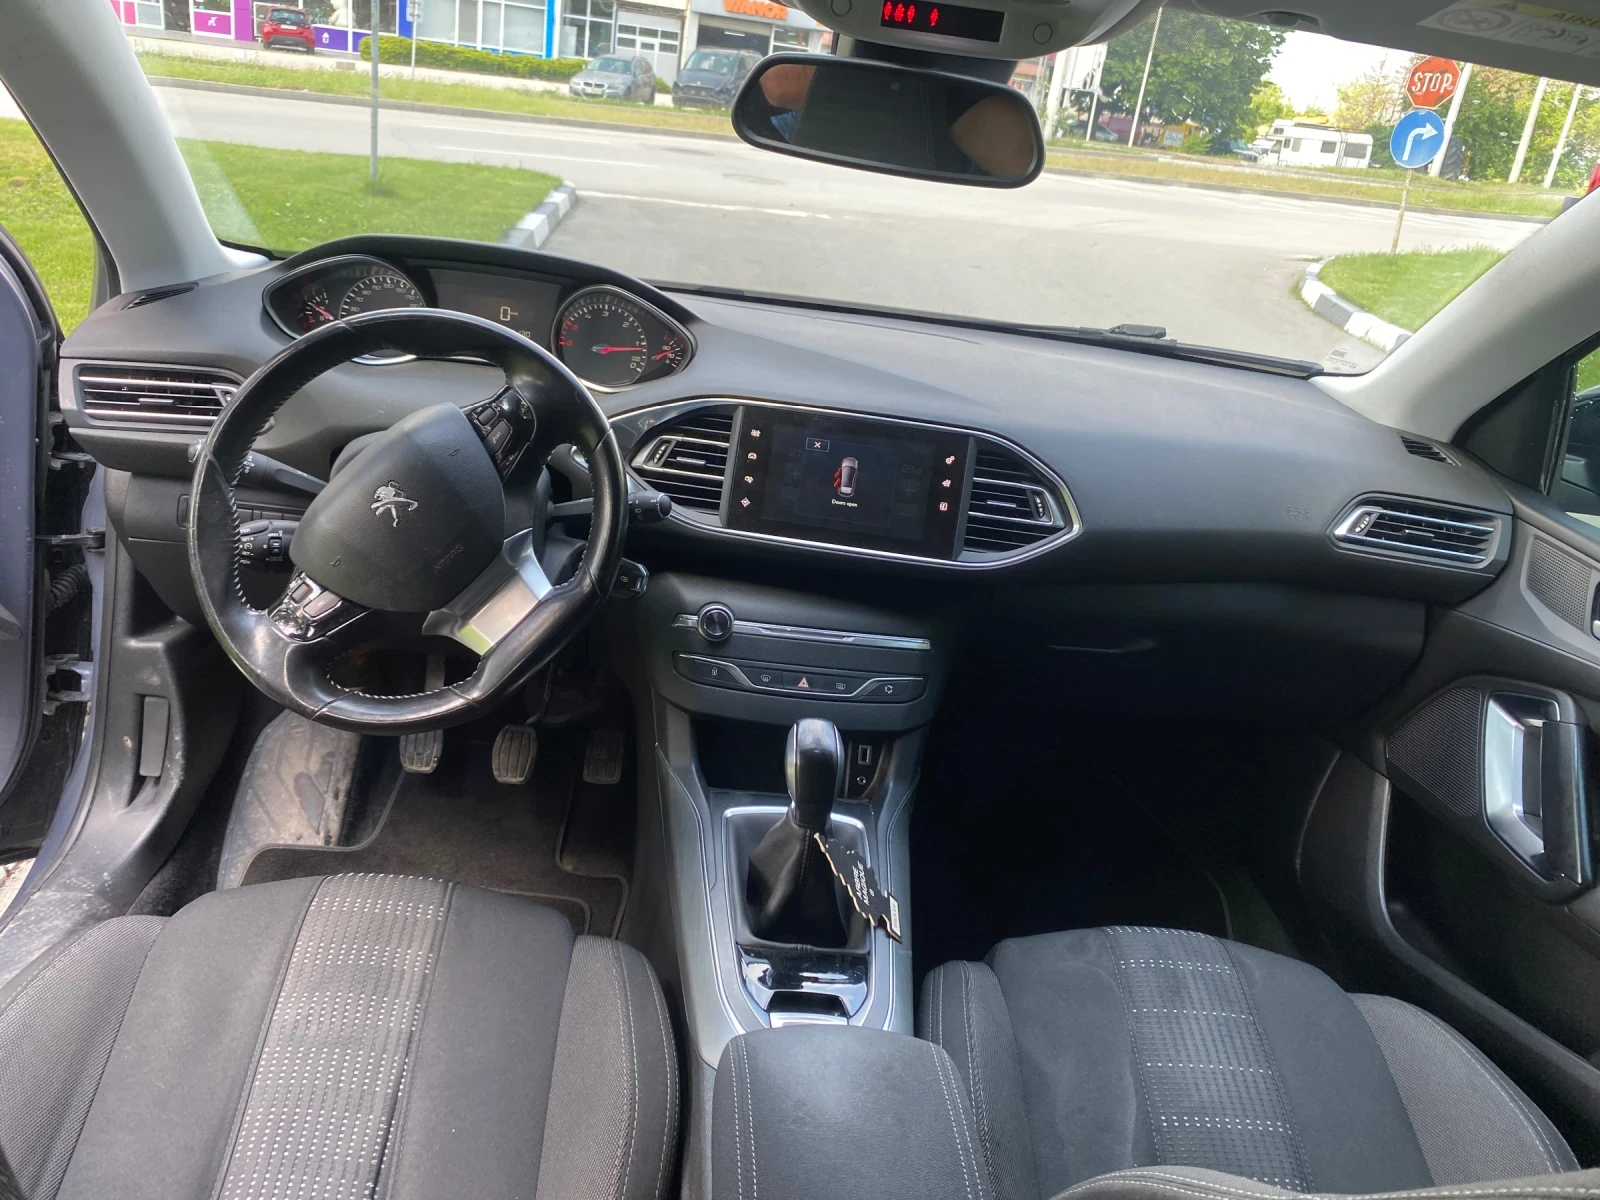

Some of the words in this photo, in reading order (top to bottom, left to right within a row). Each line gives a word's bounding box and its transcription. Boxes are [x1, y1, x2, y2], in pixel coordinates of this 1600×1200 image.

[723, 0, 788, 21] VIANOR
[1411, 71, 1453, 94] STOP
[852, 865, 863, 900] ARBRE
[857, 860, 870, 906] MAGIQUE
